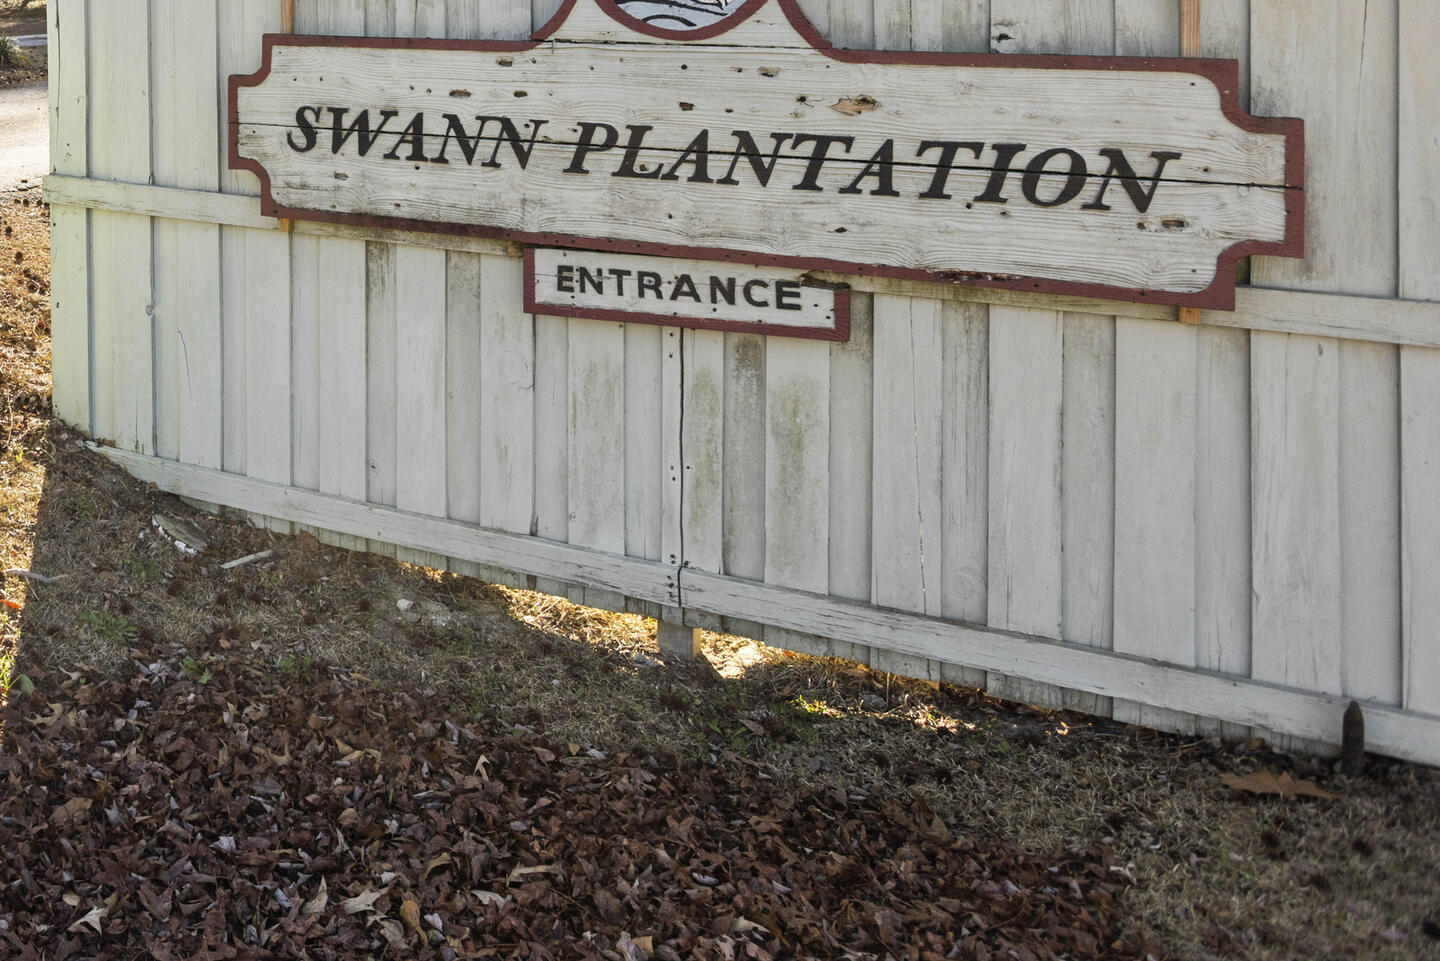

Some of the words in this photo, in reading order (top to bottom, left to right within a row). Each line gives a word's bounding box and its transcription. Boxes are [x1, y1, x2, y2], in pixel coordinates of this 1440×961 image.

[286, 105, 549, 170] SWANN
[562, 121, 1182, 214] PLANTATION
[556, 264, 802, 311] ENTRANCE
